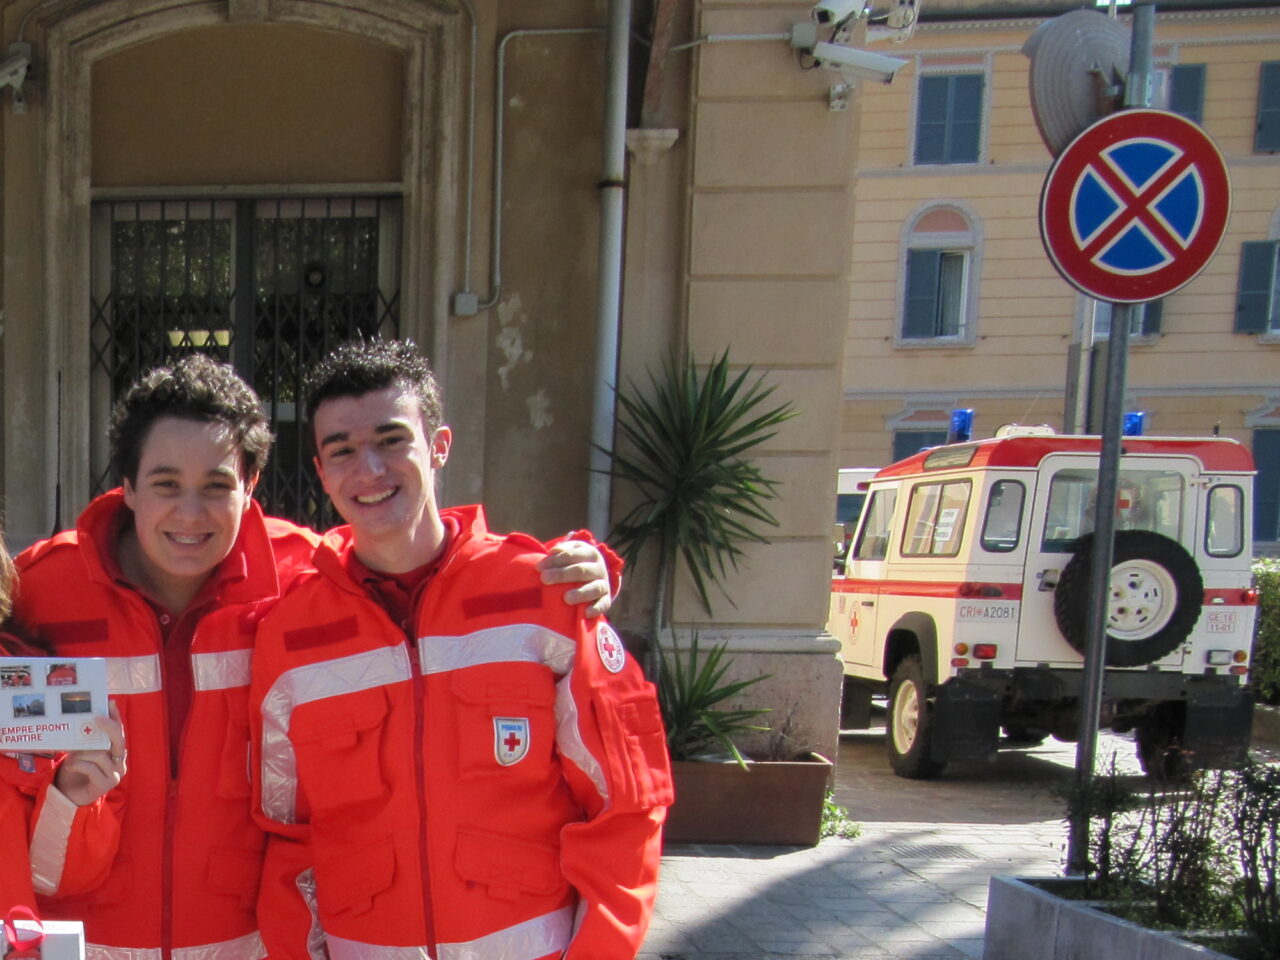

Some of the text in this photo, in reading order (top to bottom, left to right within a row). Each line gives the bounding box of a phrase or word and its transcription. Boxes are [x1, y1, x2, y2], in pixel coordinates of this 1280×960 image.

[959, 606, 1015, 619] CRI A2081
[0, 722, 70, 736] EMPRE PRONTI
[5, 733, 43, 744] PARTIRE
